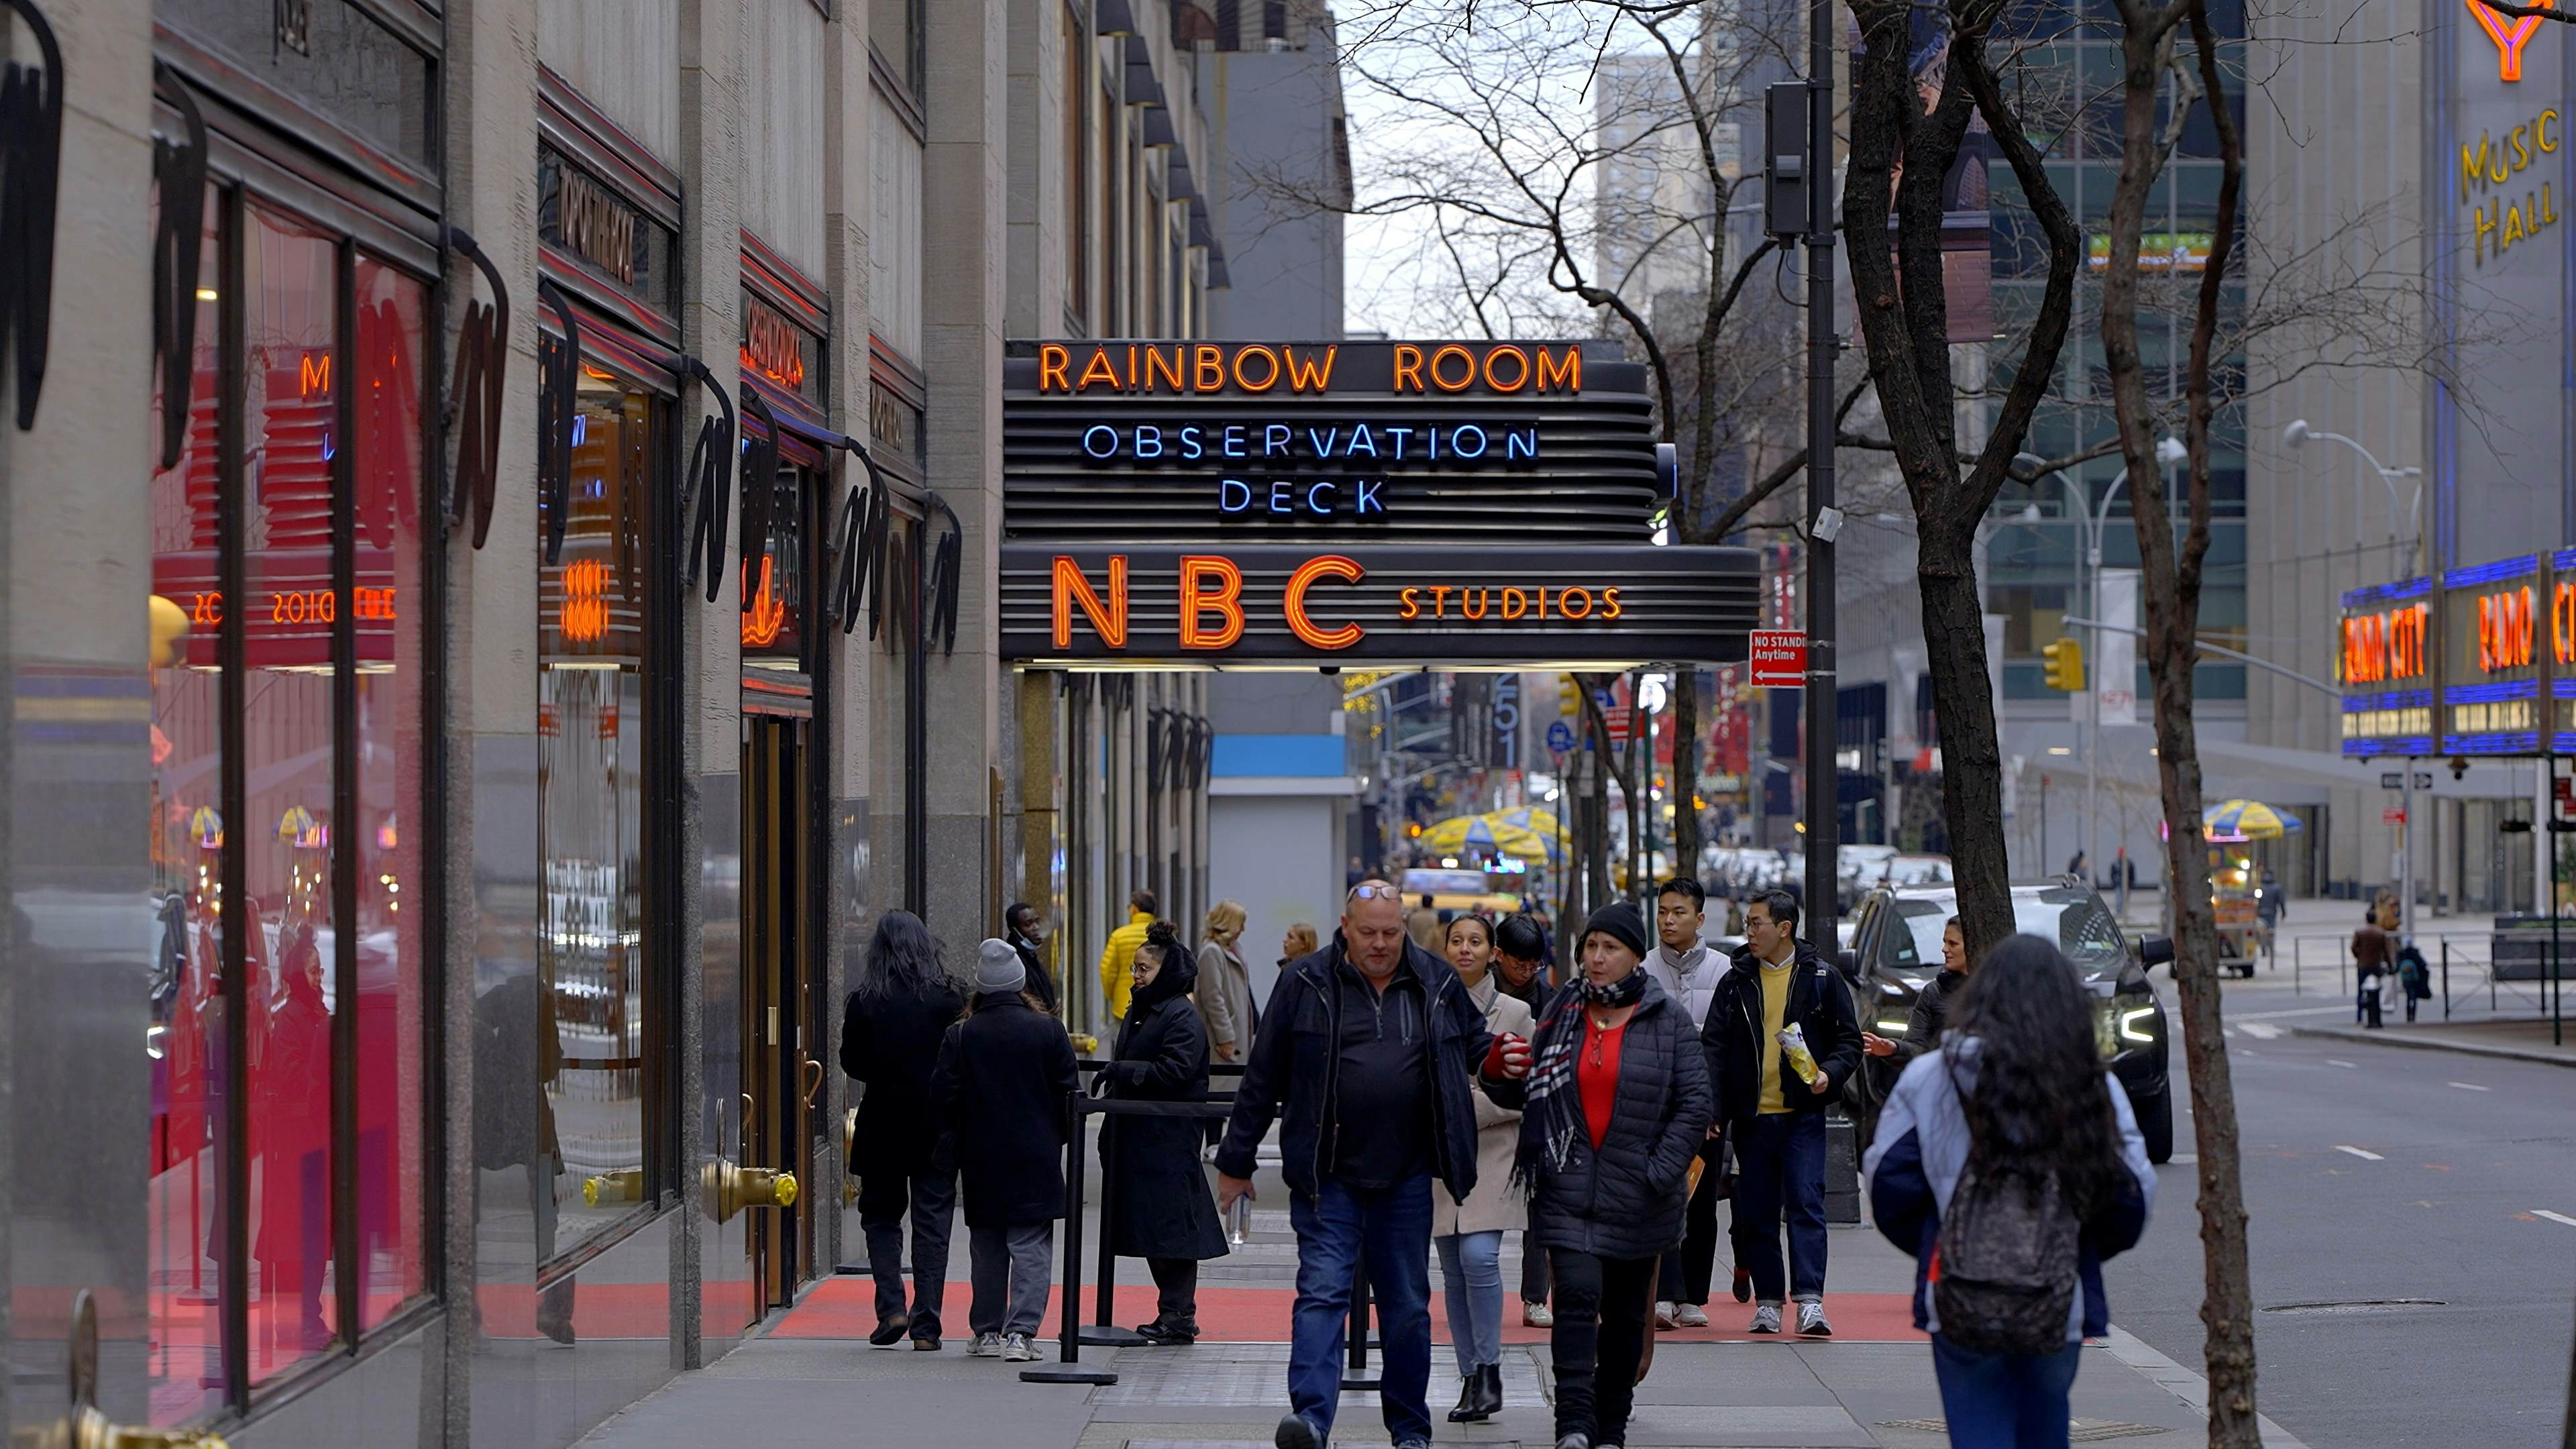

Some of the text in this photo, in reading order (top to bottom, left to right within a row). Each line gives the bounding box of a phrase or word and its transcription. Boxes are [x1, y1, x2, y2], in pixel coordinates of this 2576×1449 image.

[2461, 108, 2559, 205] MUSIC
[2475, 182, 2558, 269] HALL
[1038, 343, 1581, 394] RAINBOW ROOM
[1083, 423, 1538, 460] OBSERVATION
[1219, 478, 1385, 515] DECK
[1052, 554, 1623, 650] NBC STUDIOS
[1754, 649, 1796, 662] Anytime
[1755, 636, 1806, 647] NO STANDI
[2390, 602, 2426, 679] CITY
